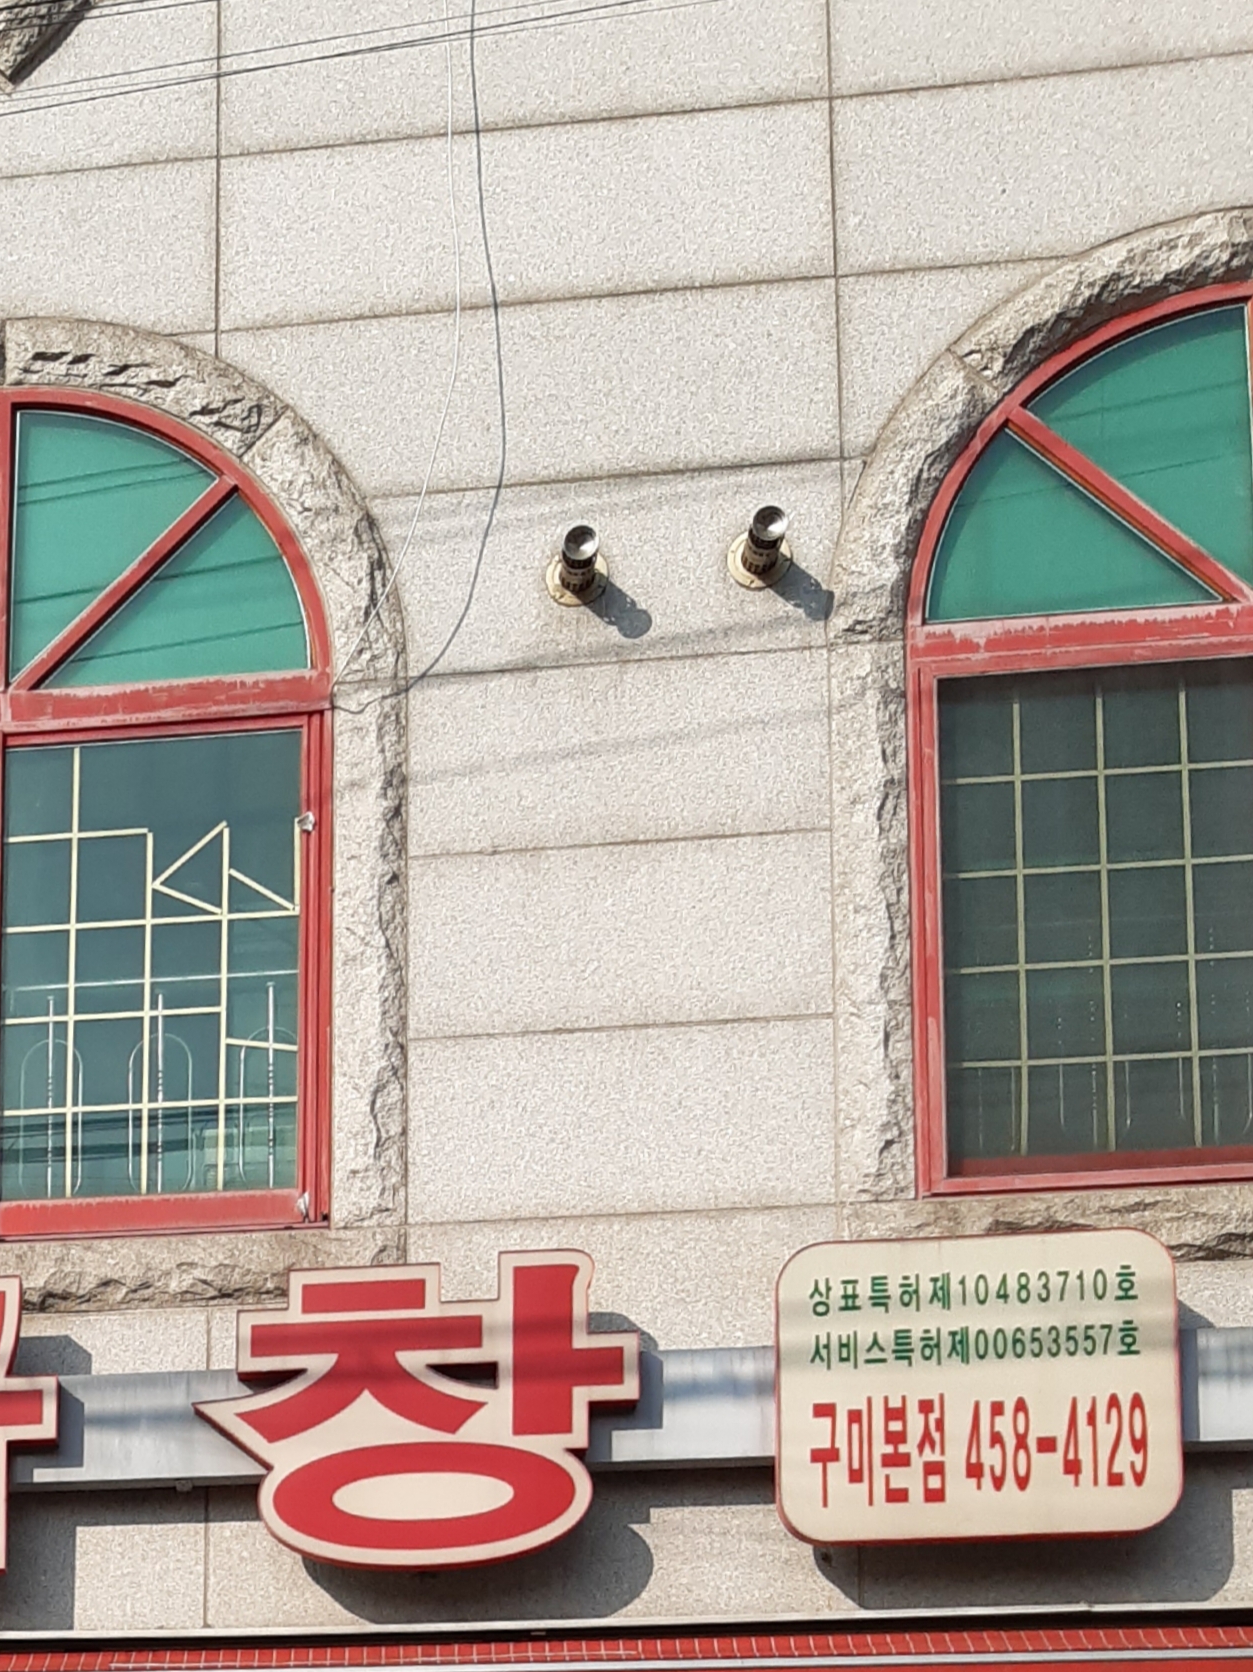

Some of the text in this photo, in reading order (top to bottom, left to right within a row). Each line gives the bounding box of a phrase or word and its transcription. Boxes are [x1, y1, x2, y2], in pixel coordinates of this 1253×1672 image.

[808, 1264, 1140, 1317] 상표특허제10483710호
[809, 1319, 1141, 1370] 서비스특허제00653557호
[810, 1391, 1150, 1508] 구미본점 458-4129
